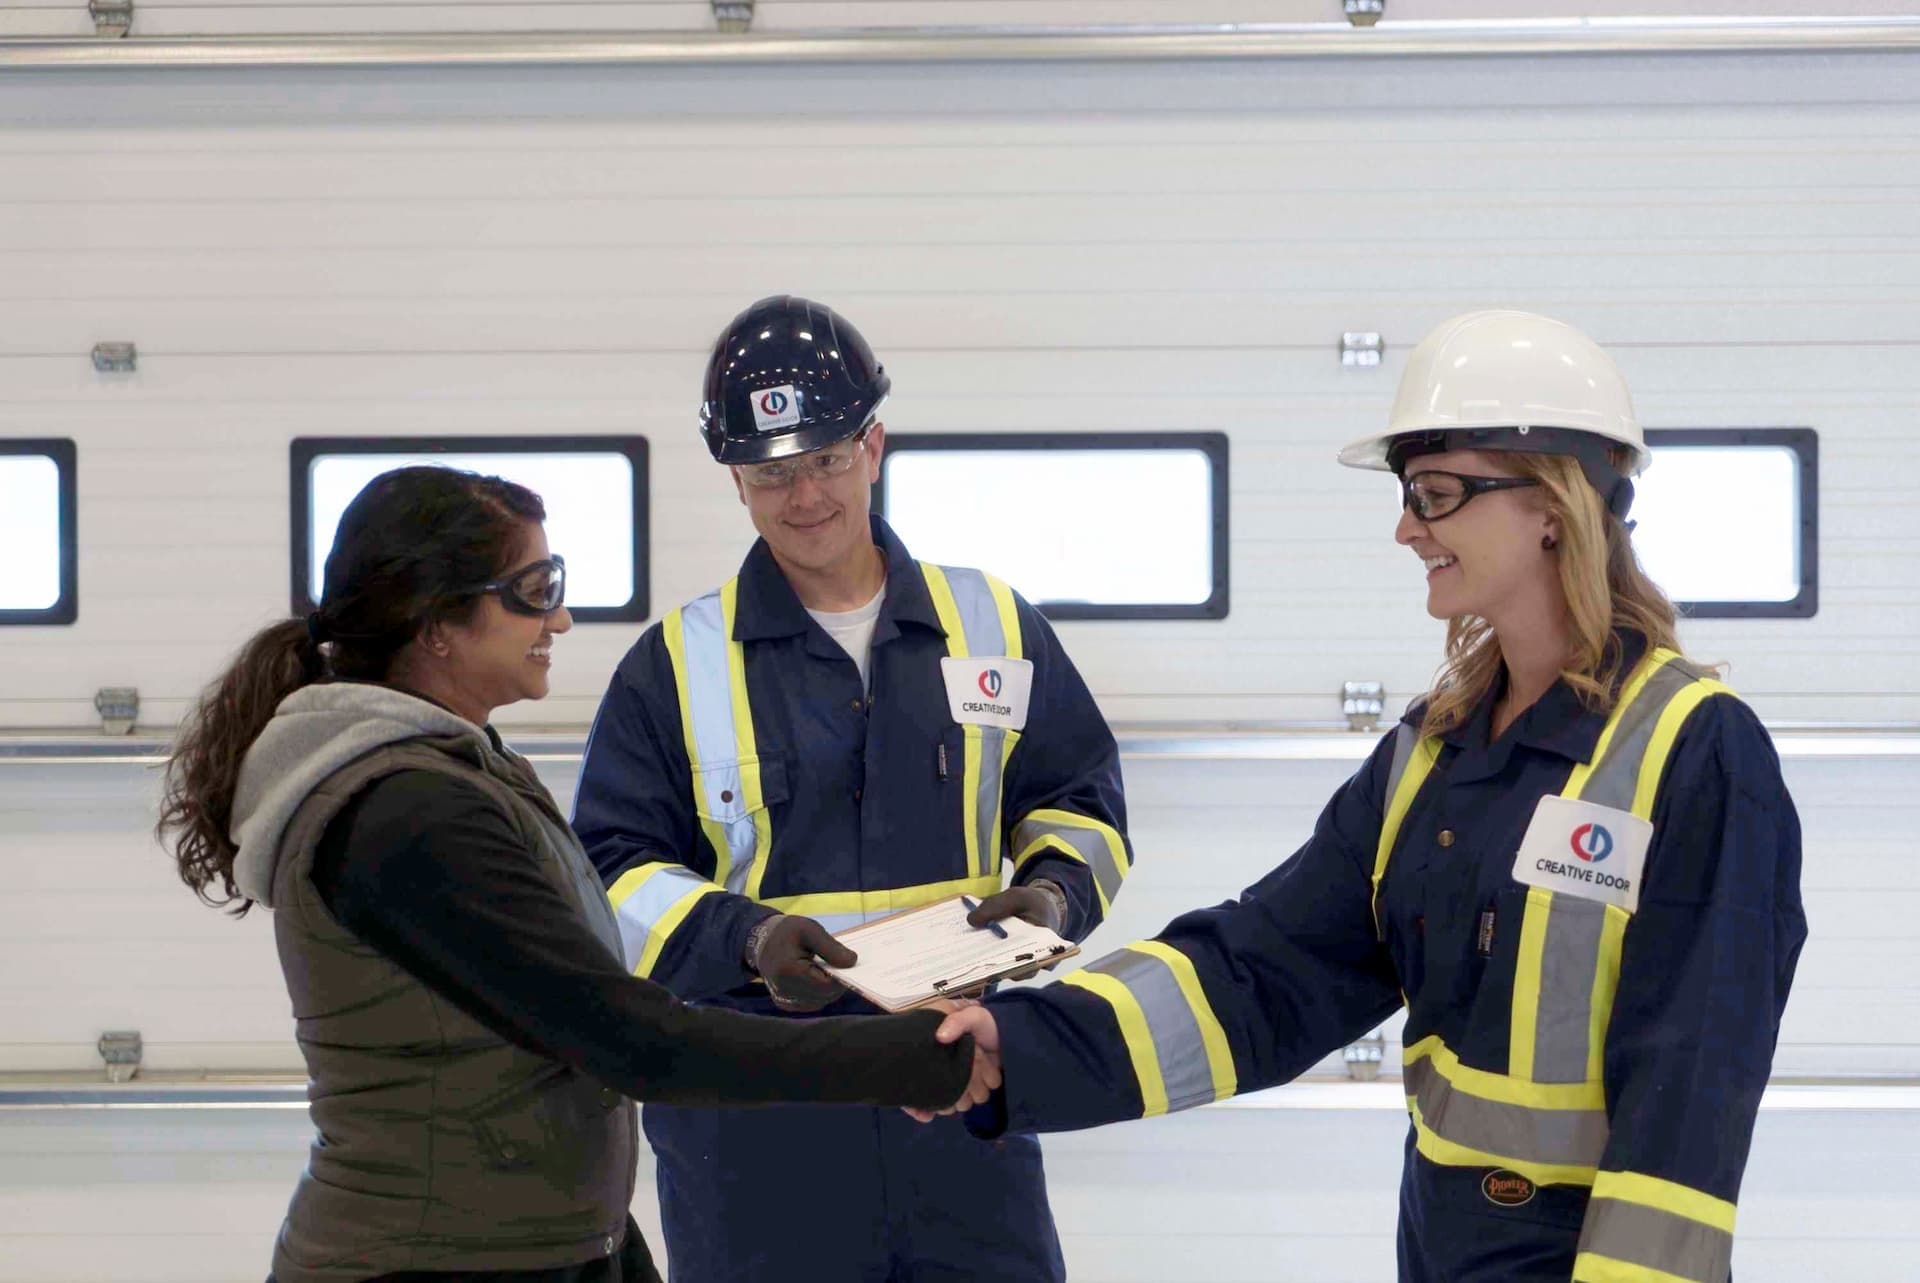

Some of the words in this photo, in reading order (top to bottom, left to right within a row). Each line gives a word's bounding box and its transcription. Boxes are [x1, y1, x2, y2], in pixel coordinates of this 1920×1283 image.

[962, 702, 996, 714] CREATIVE
[1536, 858, 1593, 882] CREATIVE
[1595, 872, 1631, 892] DOOR
